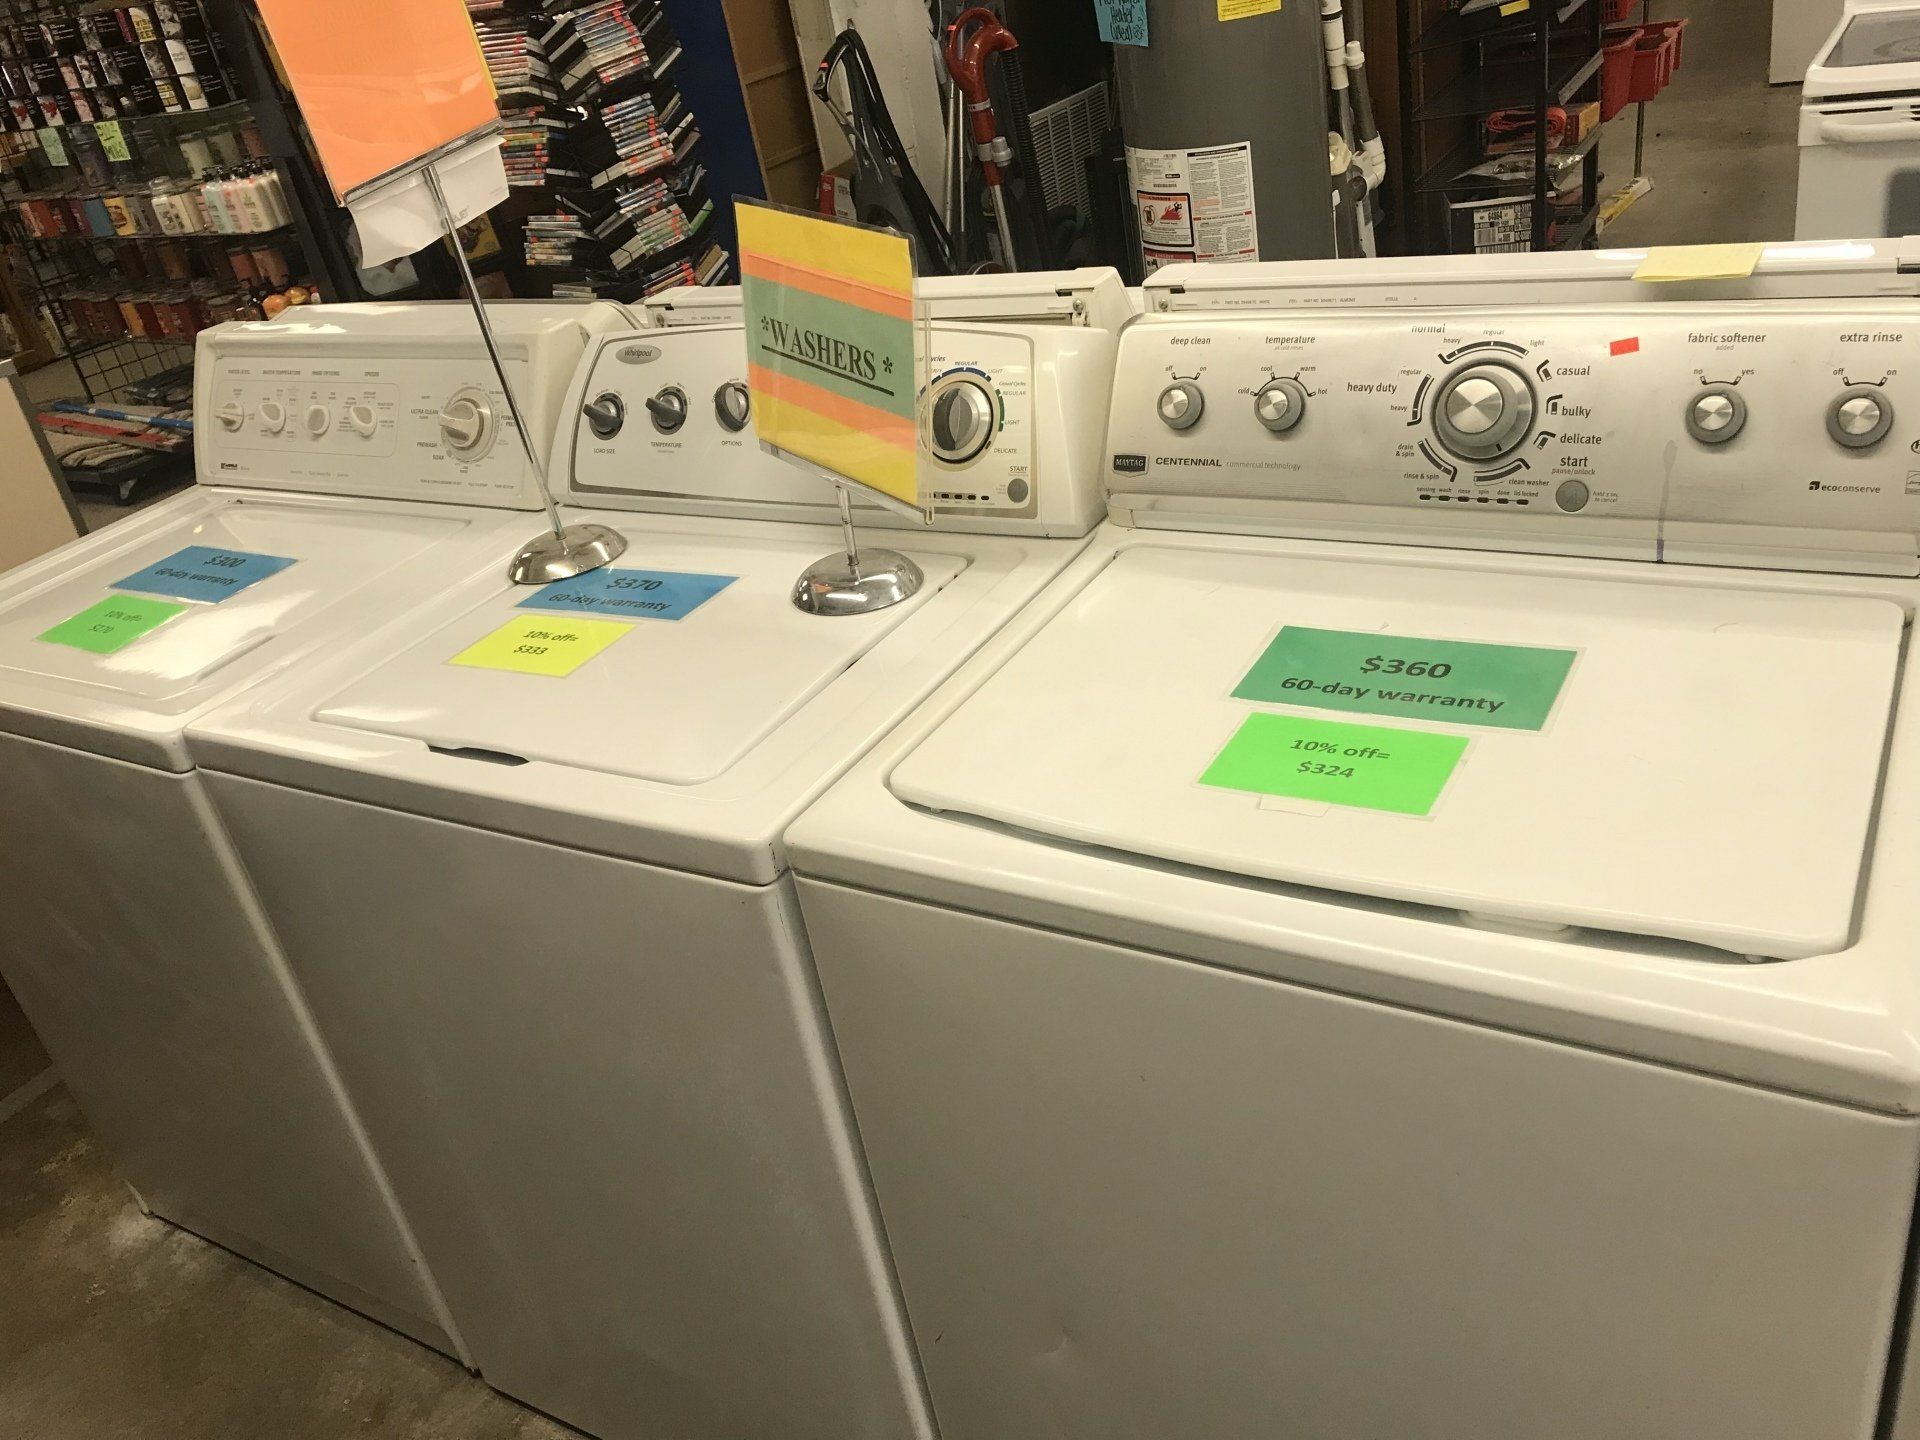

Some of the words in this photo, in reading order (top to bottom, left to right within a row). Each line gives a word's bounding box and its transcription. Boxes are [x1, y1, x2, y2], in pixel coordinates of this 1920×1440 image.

[1170, 336, 1188, 345] deep
[1190, 336, 1211, 344] clean
[1265, 336, 1315, 345] temperature
[1688, 333, 1718, 343] fabric
[1720, 333, 1766, 343] softener
[1840, 334, 1869, 342] extra
[1872, 332, 1902, 342] rinse
[1556, 366, 1590, 376] casual
[1833, 368, 1844, 376] off
[1347, 382, 1374, 393] heavy
[1376, 383, 1397, 394] duty
[1562, 406, 1591, 418] bulky
[1560, 434, 1602, 445] delicate
[1115, 458, 1144, 467] MAYTAG
[1156, 457, 1222, 467] CENTENNIAL
[1227, 461, 1264, 469] commercial
[1264, 461, 1301, 471] technology
[1560, 456, 1588, 467] start
[1821, 484, 1880, 493] ecoconserve
[606, 576, 664, 591] $370
[548, 593, 601, 607] 60-day
[601, 598, 672, 612] warranty
[522, 630, 550, 641] 10%
[551, 632, 579, 642] off=
[513, 644, 548, 655] $333
[1360, 654, 1451, 679] $360
[1280, 676, 1371, 699] 60-day
[1378, 686, 1504, 714] warranty
[1290, 738, 1336, 754] 10%
[1343, 746, 1390, 760] off=
[1297, 760, 1354, 778] $324
